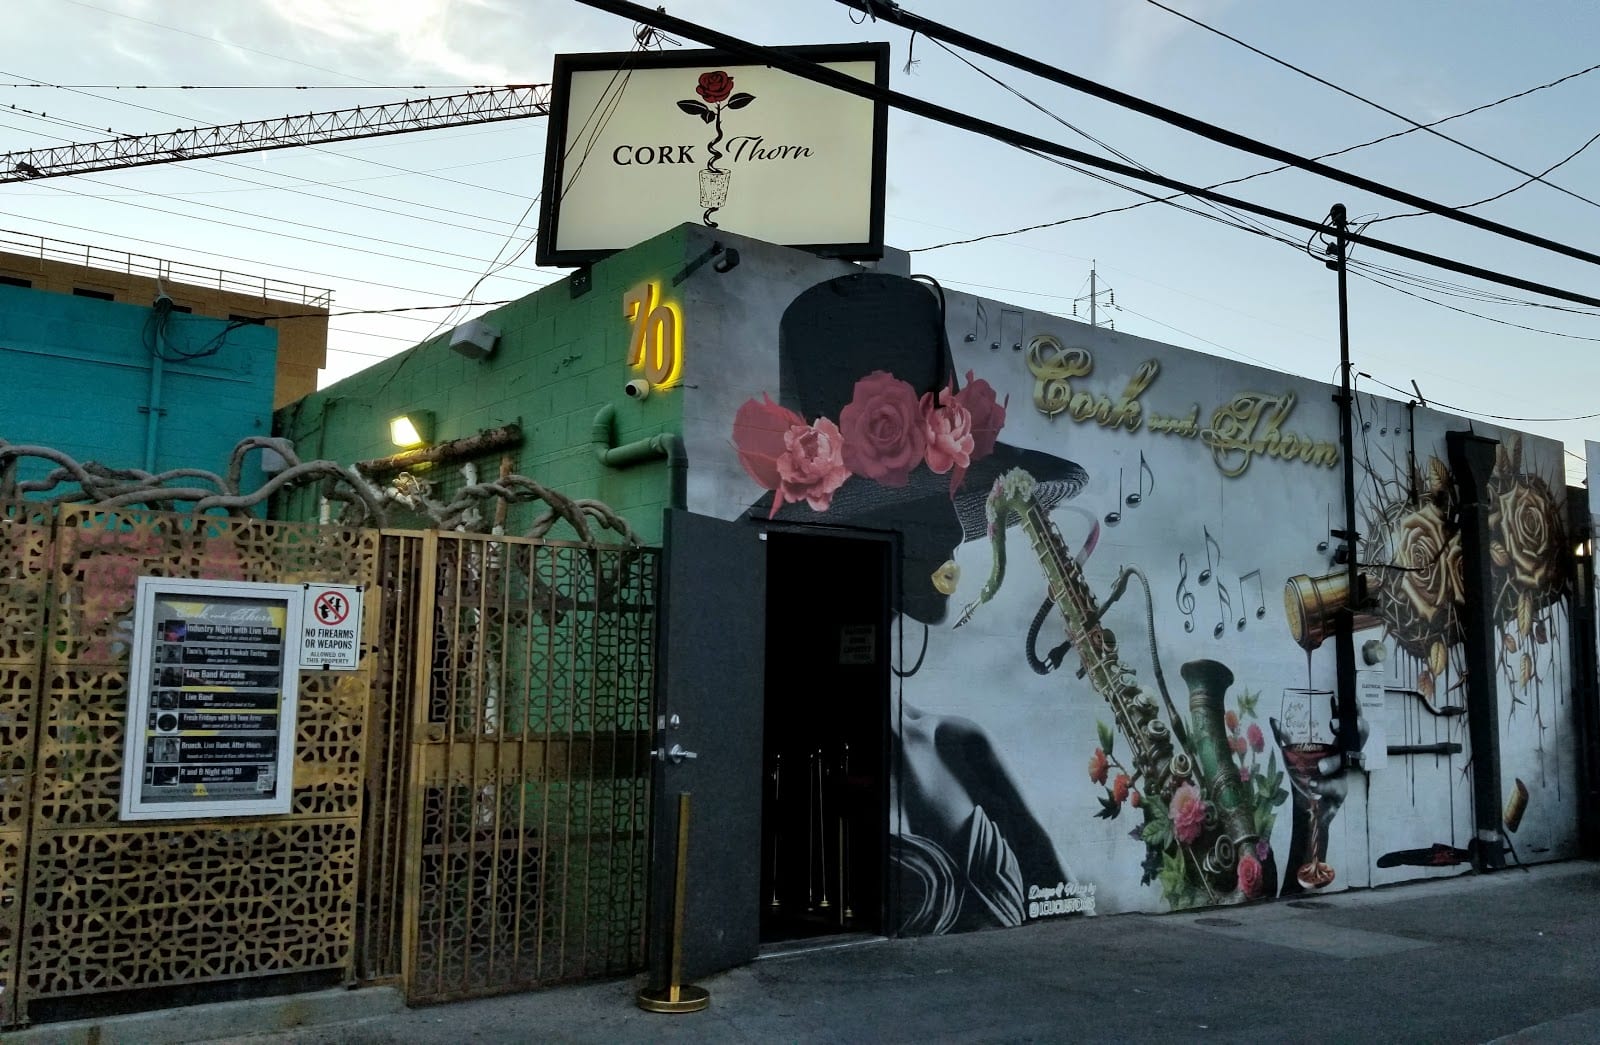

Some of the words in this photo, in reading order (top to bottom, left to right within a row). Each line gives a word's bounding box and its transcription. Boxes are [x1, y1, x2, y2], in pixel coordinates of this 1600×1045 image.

[612, 144, 696, 166] CORK
[725, 135, 815, 163] Thorn
[623, 283, 677, 385] 70
[1026, 334, 1161, 433] Cork
[1200, 390, 1341, 478] Thorn
[187, 623, 214, 634] Industry
[215, 625, 233, 635] Night
[234, 626, 248, 634] with
[249, 627, 262, 635] Live
[305, 628, 316, 638] NO
[317, 628, 354, 639] FIREARMS
[305, 638, 316, 649] OR
[317, 640, 353, 650] WEAPONS
[186, 669, 200, 679] Live
[201, 670, 218, 679] Band
[219, 670, 246, 680] Karaoke
[185, 693, 198, 701] Live
[198, 693, 213, 701] Band
[231, 741, 245, 749] After
[204, 768, 220, 776] Night
